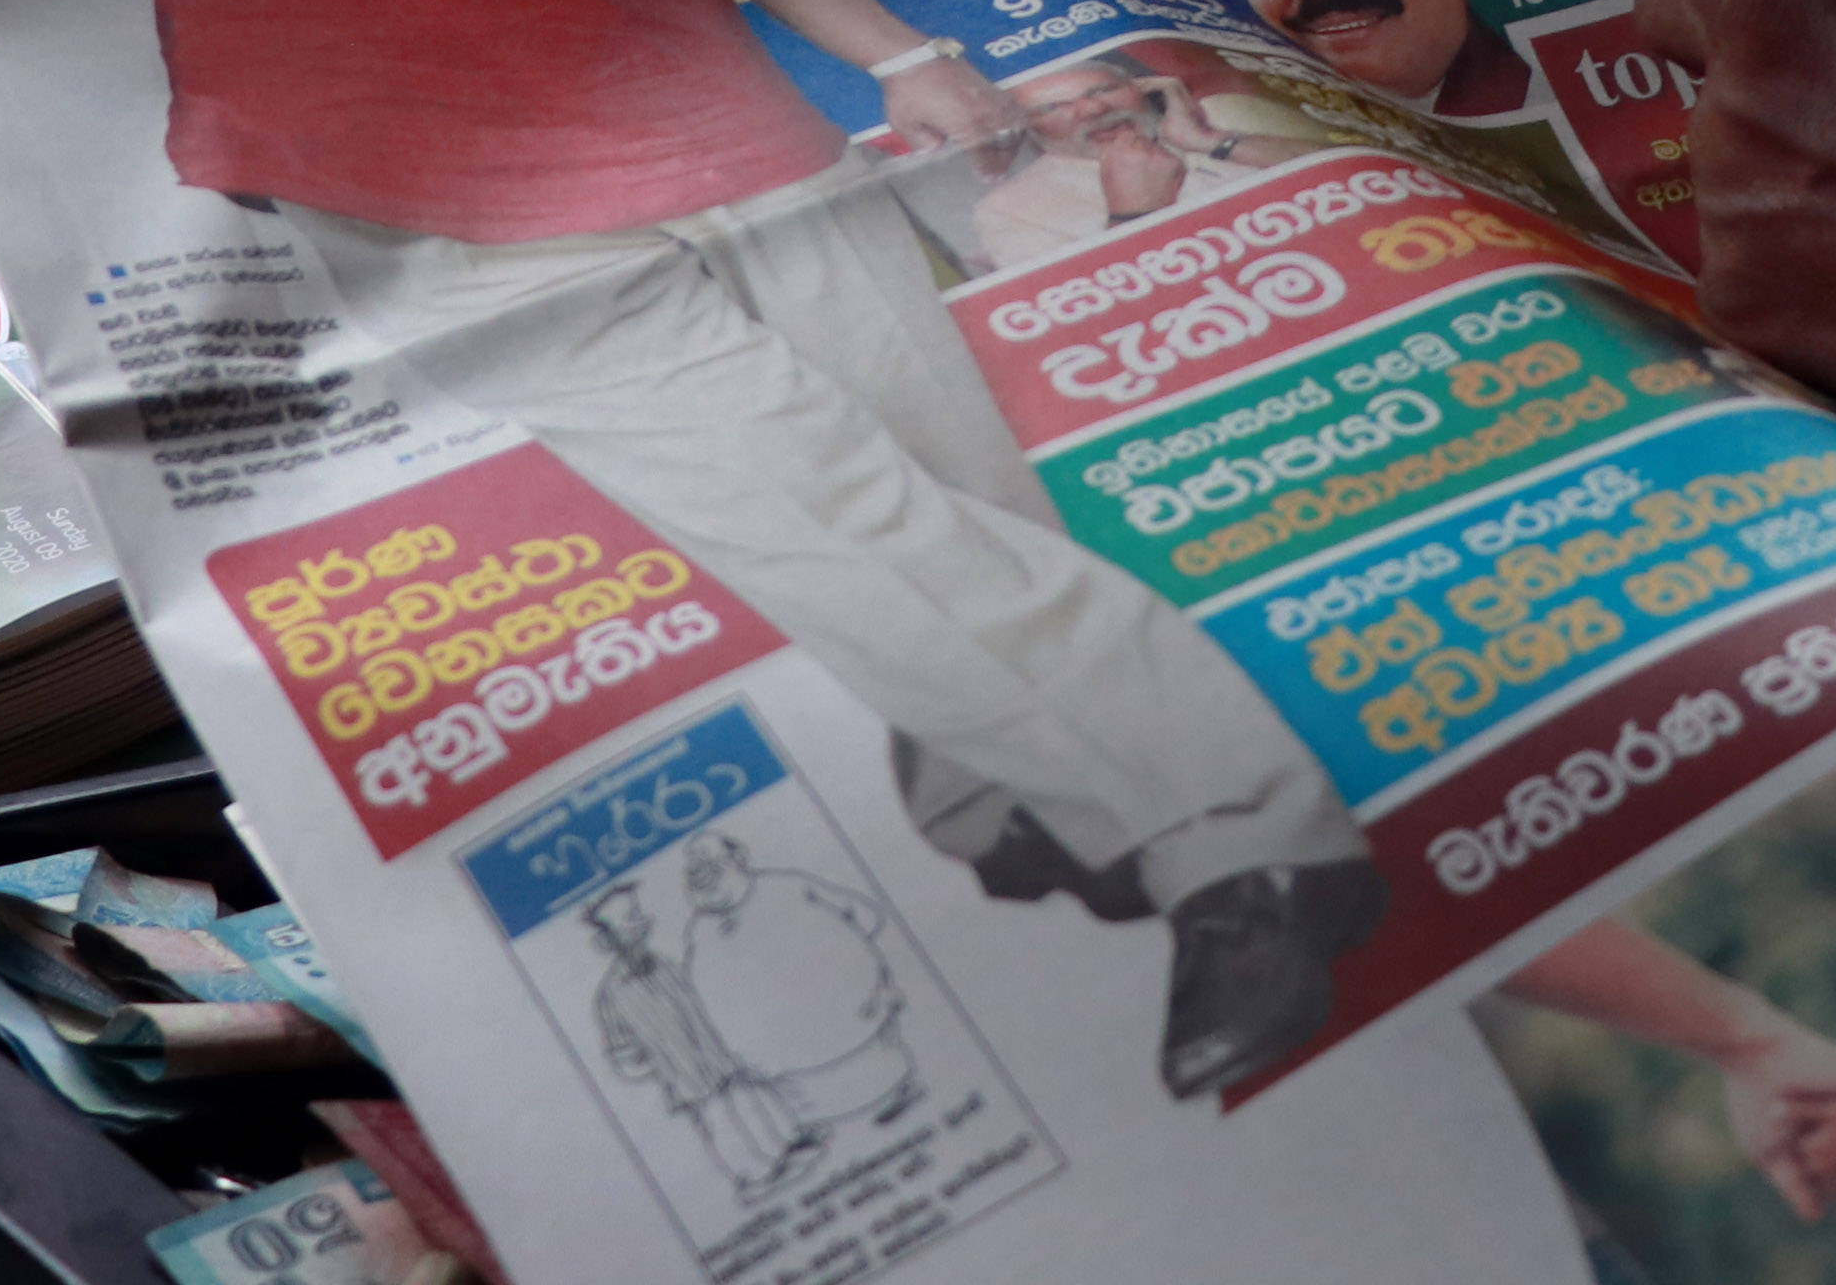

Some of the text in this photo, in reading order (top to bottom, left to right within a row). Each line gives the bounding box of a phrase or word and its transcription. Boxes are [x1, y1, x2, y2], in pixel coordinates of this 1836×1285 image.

[1040, 253, 1344, 403] දැක්ම
[0, 506, 64, 561] August 09
[46, 507, 91, 551] Sunday
[317, 549, 689, 740] වෙනසකට
[355, 597, 721, 808] අනුමැතිය
